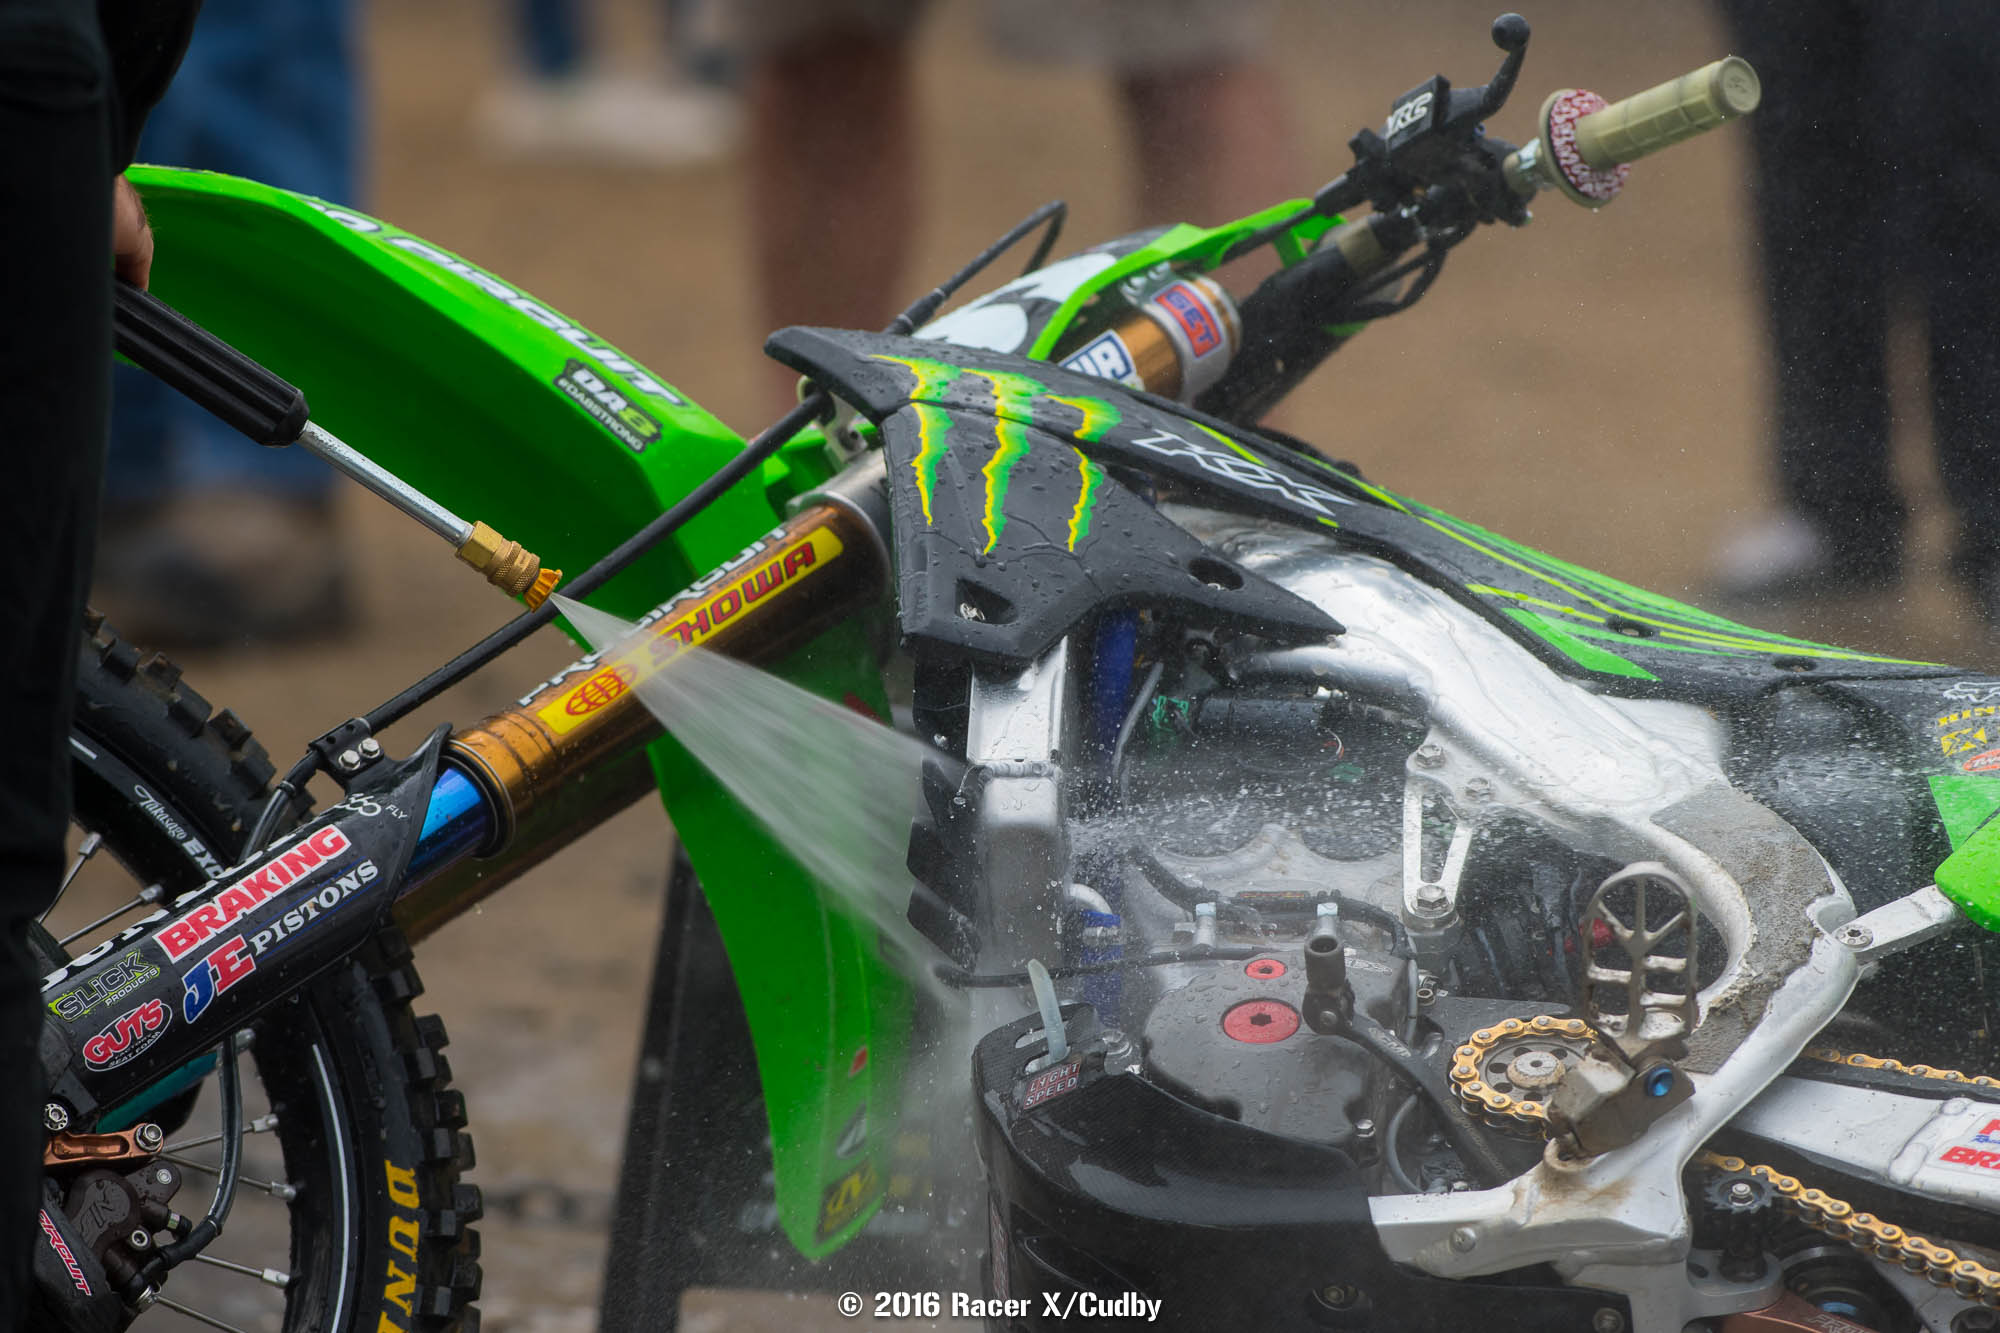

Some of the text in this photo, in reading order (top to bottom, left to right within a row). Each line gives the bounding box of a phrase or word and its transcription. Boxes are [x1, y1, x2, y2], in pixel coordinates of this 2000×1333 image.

[1165, 290, 1216, 345] GET
[648, 540, 817, 665] SHOWA
[134, 784, 188, 840] Takasago
[385, 804, 408, 819] FLY
[155, 826, 350, 960] BRAKING
[182, 934, 257, 1024] JE
[250, 859, 379, 956] PISTONS
[105, 967, 158, 1006] PRODUCTS
[83, 998, 164, 1064] GUTS
[108, 1031, 161, 1068] SEAT FOAM
[1025, 1076, 1078, 1107] SPEED
[1939, 1146, 2000, 1171] BR
